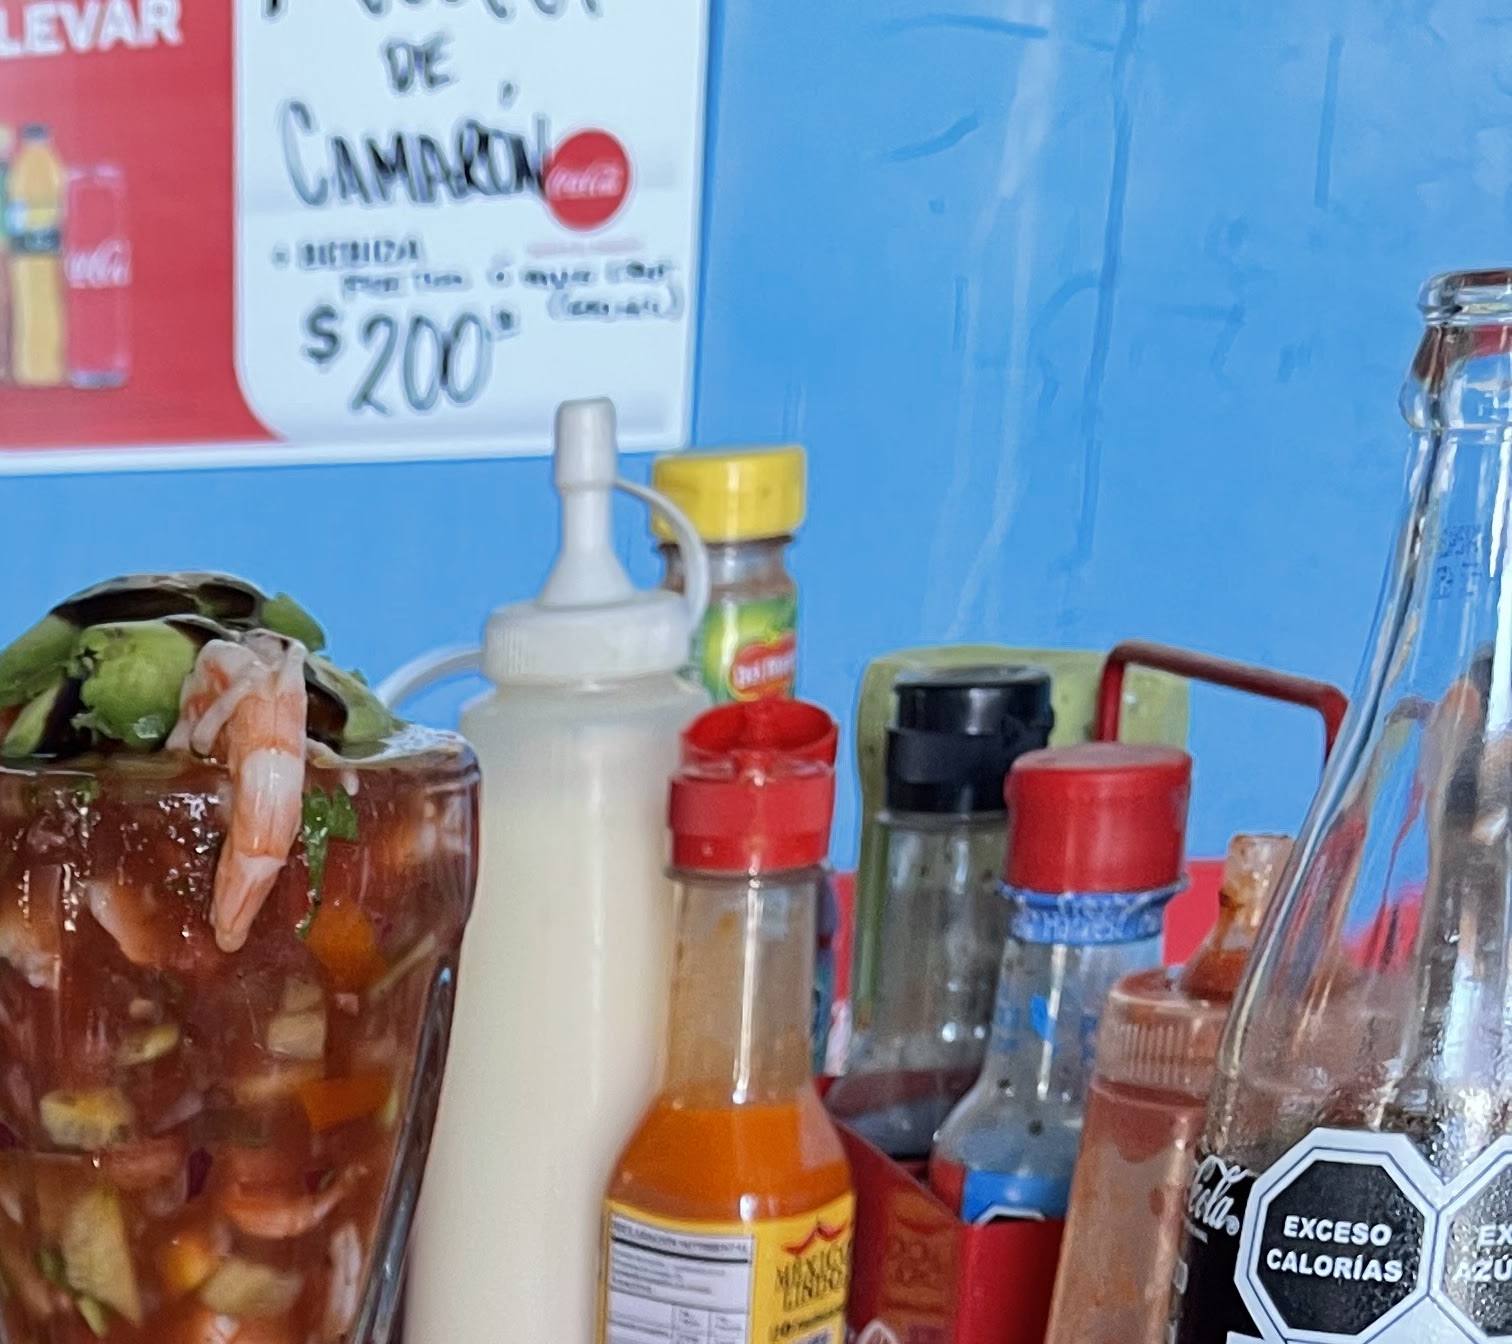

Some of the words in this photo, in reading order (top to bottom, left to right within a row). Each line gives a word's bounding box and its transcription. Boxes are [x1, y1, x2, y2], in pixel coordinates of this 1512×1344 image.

[384, 34, 454, 91] DE
[1283, 1215, 1392, 1247] EXCESO
[1266, 1248, 1403, 1283] CALORÍAS
